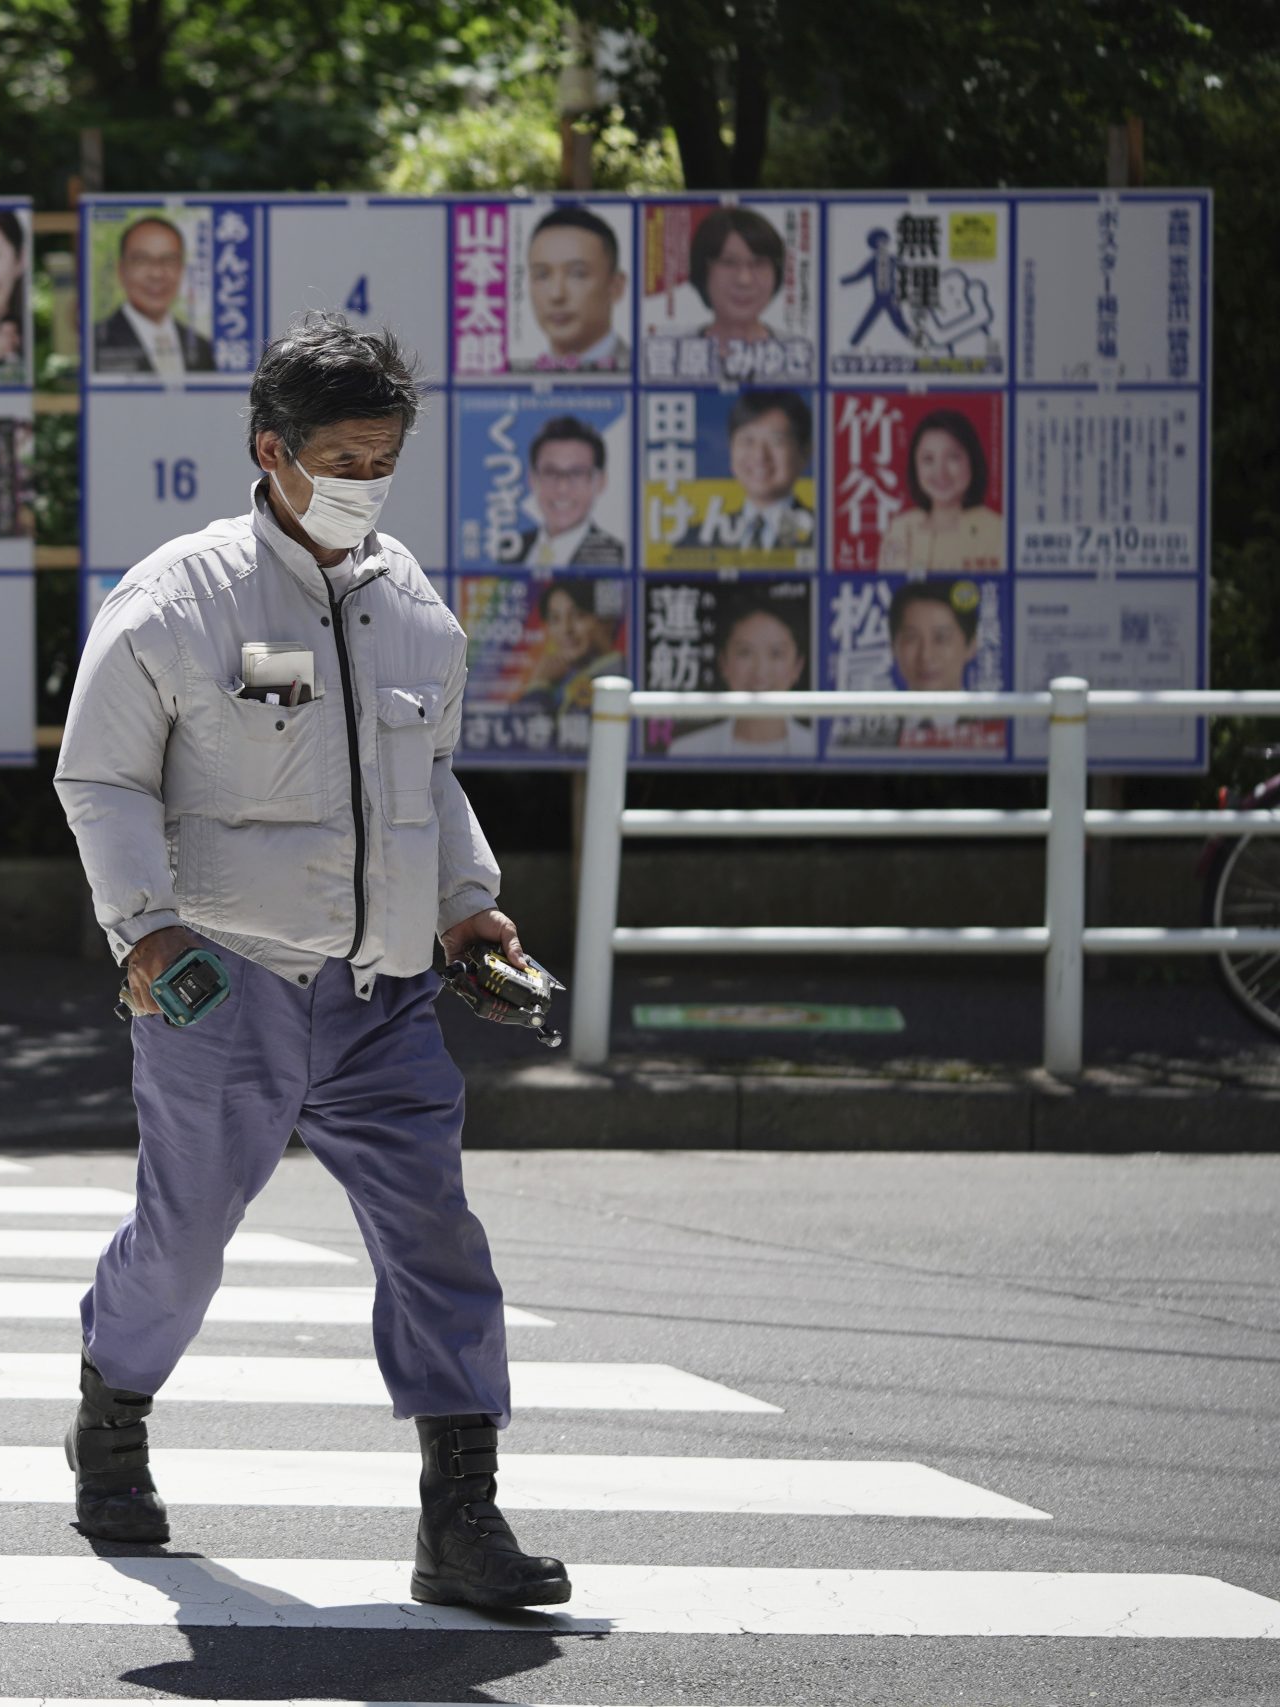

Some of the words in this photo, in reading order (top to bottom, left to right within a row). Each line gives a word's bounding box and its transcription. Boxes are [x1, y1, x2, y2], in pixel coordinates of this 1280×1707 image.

[346, 275, 369, 316] 4
[456, 206, 504, 370] 山本太郎
[896, 213, 940, 308] 無理
[152, 459, 198, 502] 16
[483, 396, 524, 563] くつざわ
[647, 392, 697, 495] 田中
[837, 395, 904, 536] 竹谷
[649, 495, 744, 545] けん
